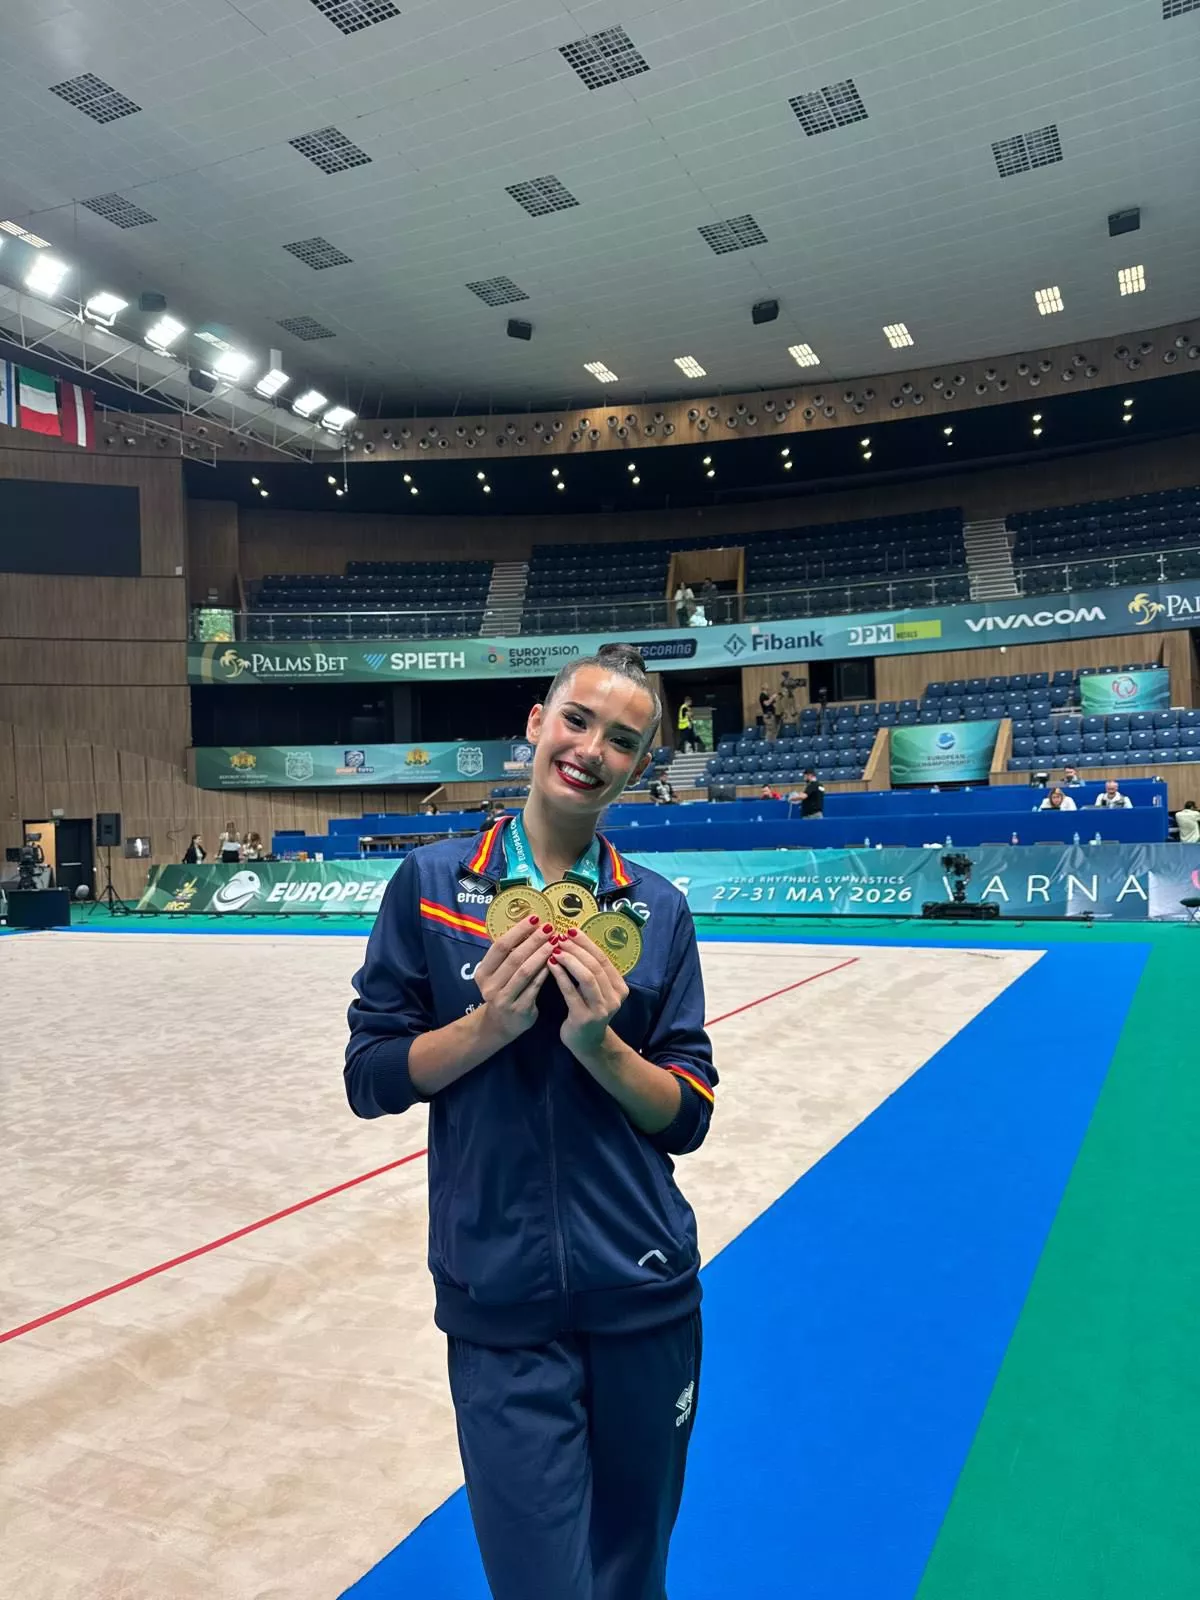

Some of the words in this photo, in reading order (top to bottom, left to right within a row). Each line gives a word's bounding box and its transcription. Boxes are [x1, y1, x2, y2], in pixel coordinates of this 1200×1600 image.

[965, 606, 1106, 632] VIVACOM
[752, 630, 823, 651] Fibank
[848, 624, 895, 646] DPM
[509, 645, 580, 658] EUROVISION
[251, 653, 312, 673] PALMS
[315, 653, 349, 673] BET
[391, 652, 465, 670] SPIETH
[509, 657, 547, 667] SPORT
[759, 875, 819, 884] RHYTHMIC
[824, 875, 904, 885] GYMNASTICS
[712, 887, 776, 901] 27-31
[786, 887, 842, 902] MAY
[851, 887, 912, 904] 2026
